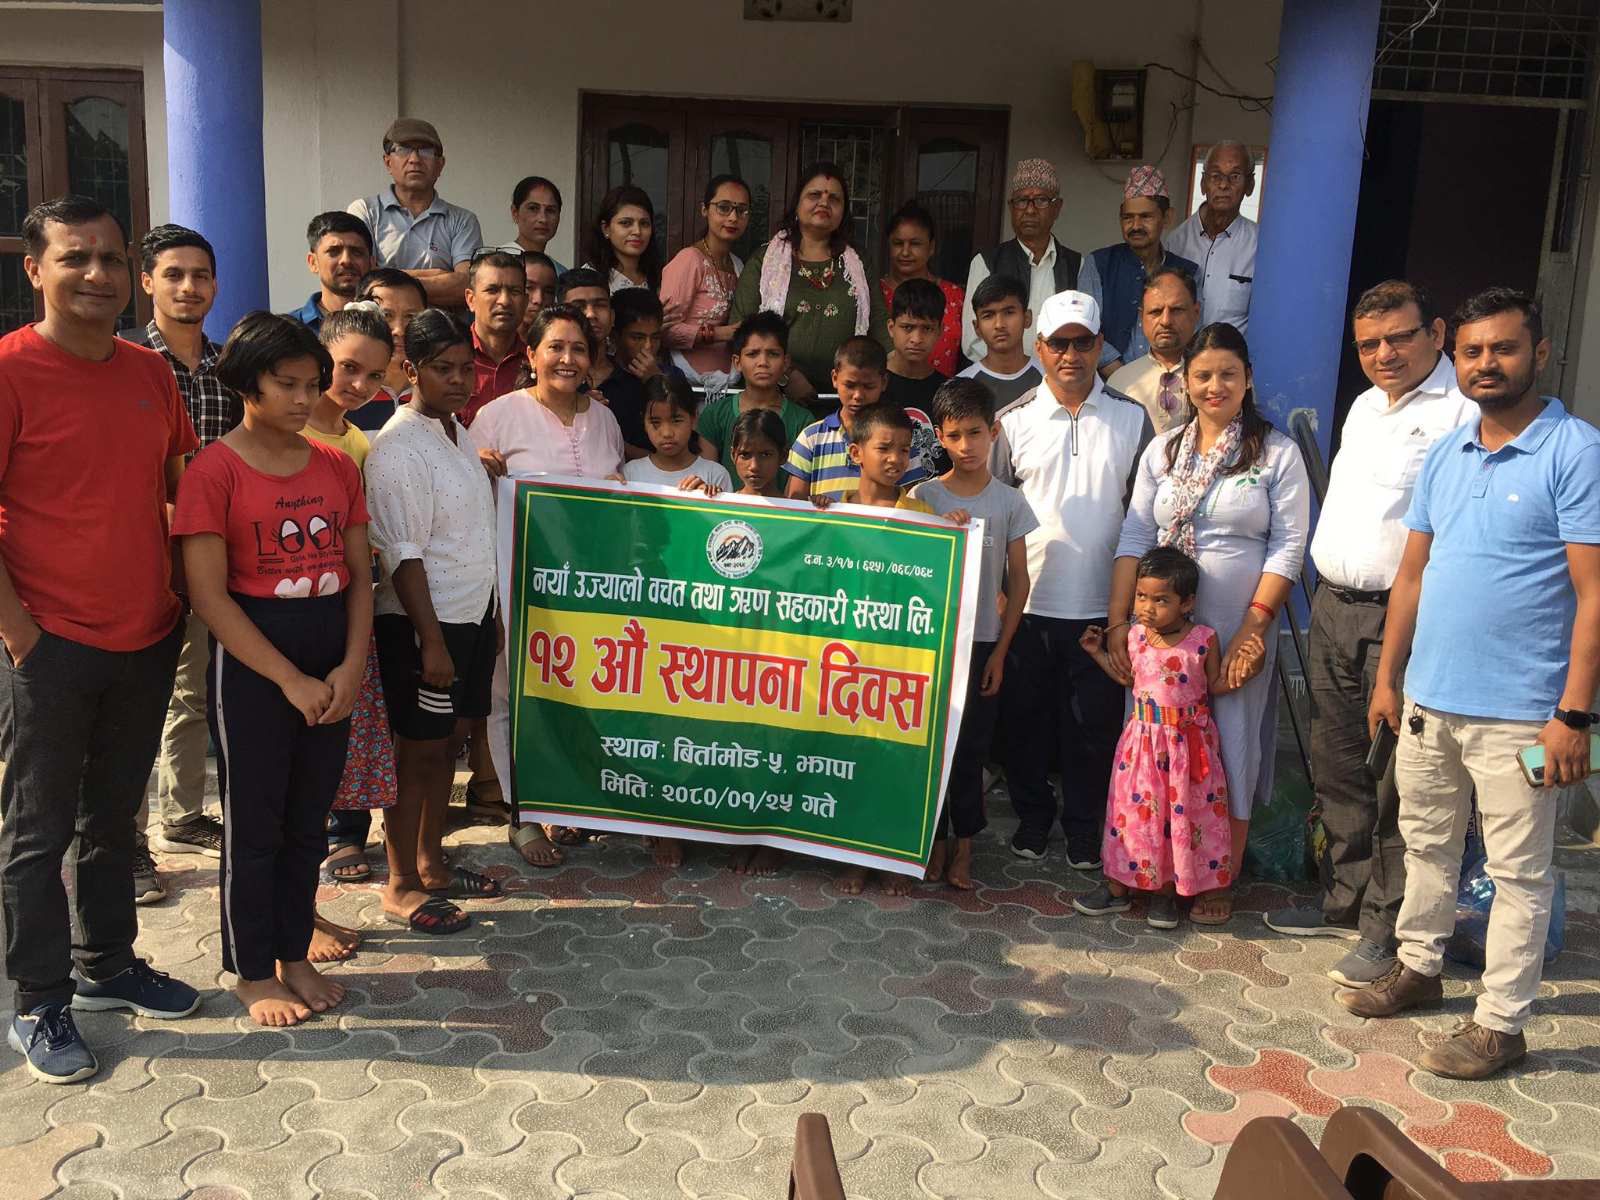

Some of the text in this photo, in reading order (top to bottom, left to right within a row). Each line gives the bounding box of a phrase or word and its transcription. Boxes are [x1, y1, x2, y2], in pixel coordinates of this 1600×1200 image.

[275, 495, 324, 511] Anything
[533, 561, 570, 597] नयाँ
[574, 567, 644, 602] उज्यालो
[690, 582, 726, 611] तथा
[729, 586, 771, 617] ऋण
[776, 588, 848, 626] सहकारी
[852, 594, 903, 632] संस्था
[907, 596, 935, 635] लि.
[528, 617, 931, 732] १२ औ स्थापना दिवस
[796, 755, 856, 780] झापा
[661, 784, 793, 813] २०८०/०१/२५
[801, 792, 838, 819] गते
